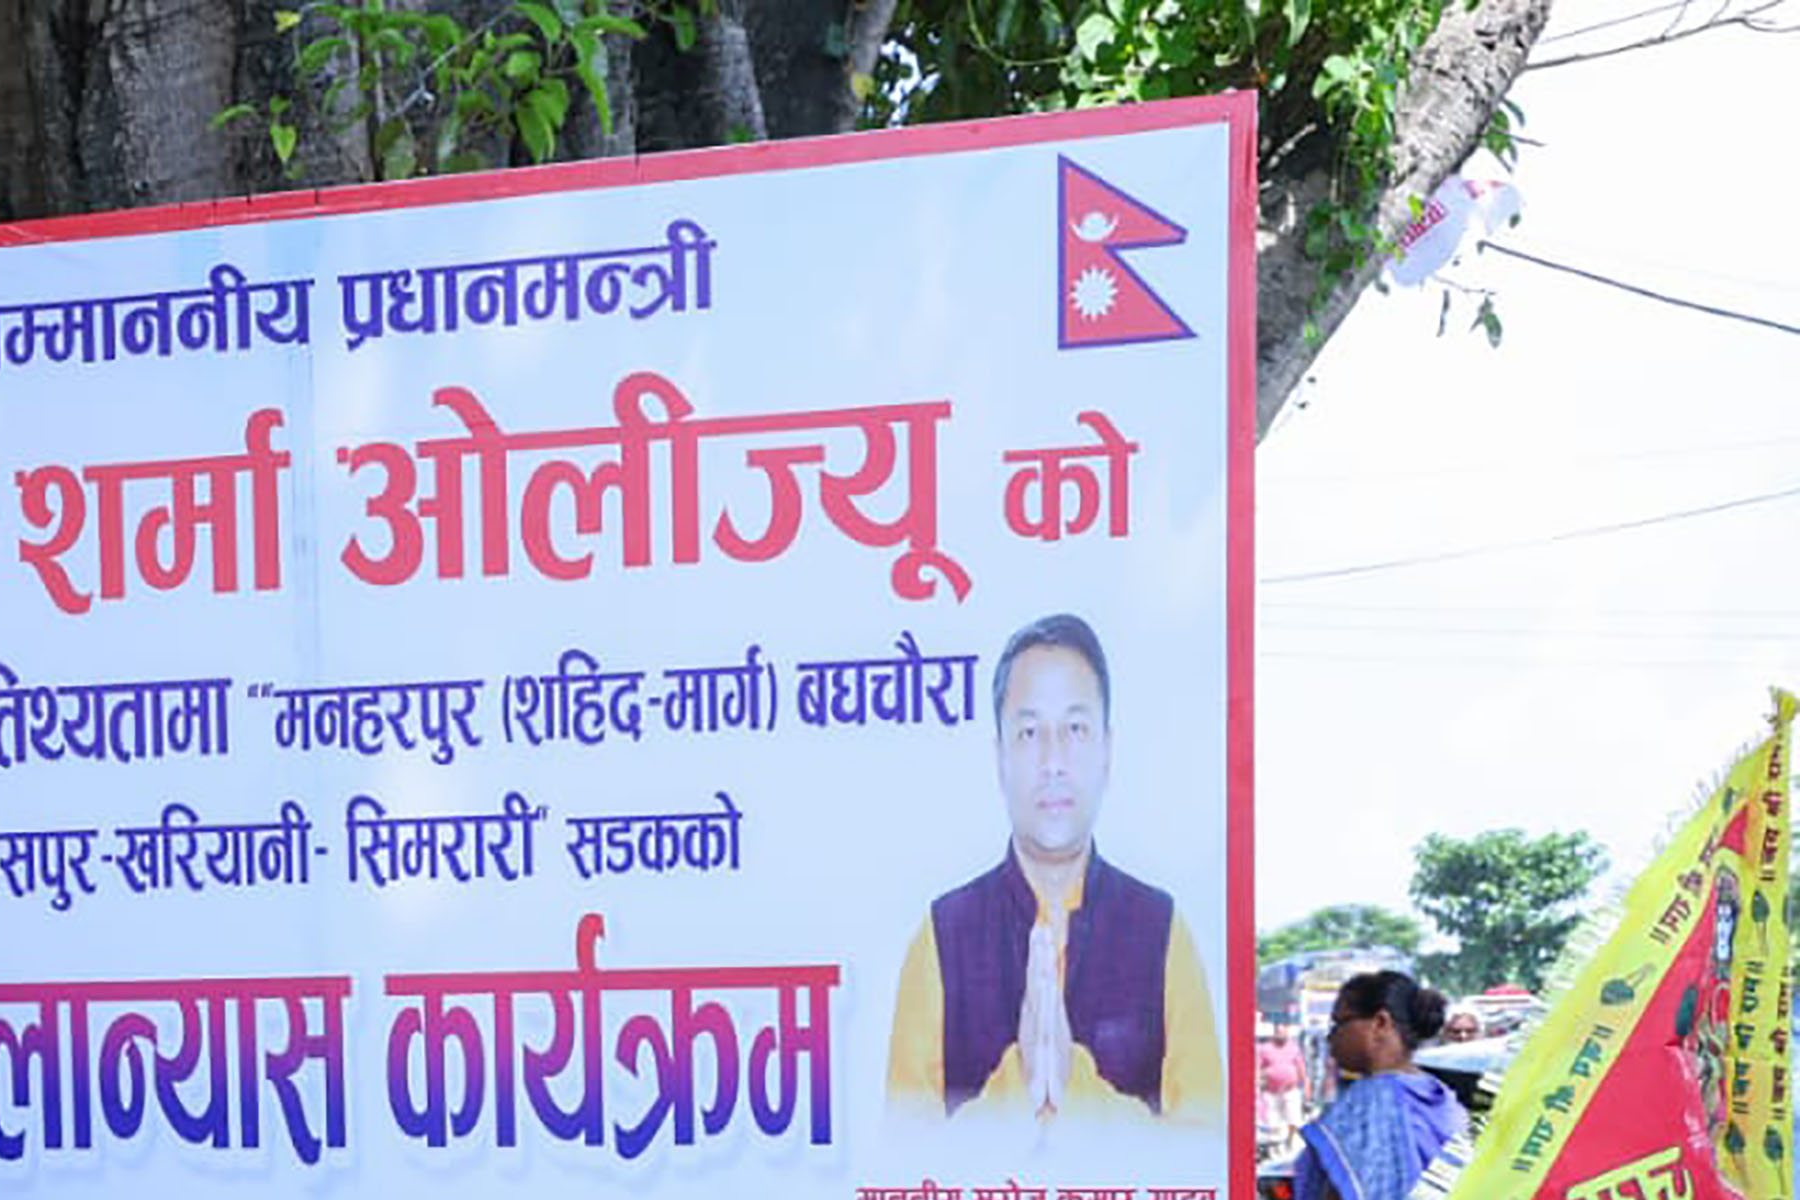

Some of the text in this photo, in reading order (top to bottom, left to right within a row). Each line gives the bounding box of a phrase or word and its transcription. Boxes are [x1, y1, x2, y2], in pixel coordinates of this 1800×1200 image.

[339, 219, 716, 349] प्रधानमन्त्री
[15, 408, 290, 614] शर्मा
[337, 372, 972, 603] ओलीज्यू
[1003, 412, 1138, 542] को
[797, 630, 978, 727] बघचौरा
[566, 791, 743, 880] सडकको
[384, 913, 841, 1160] कार्यक्रम
